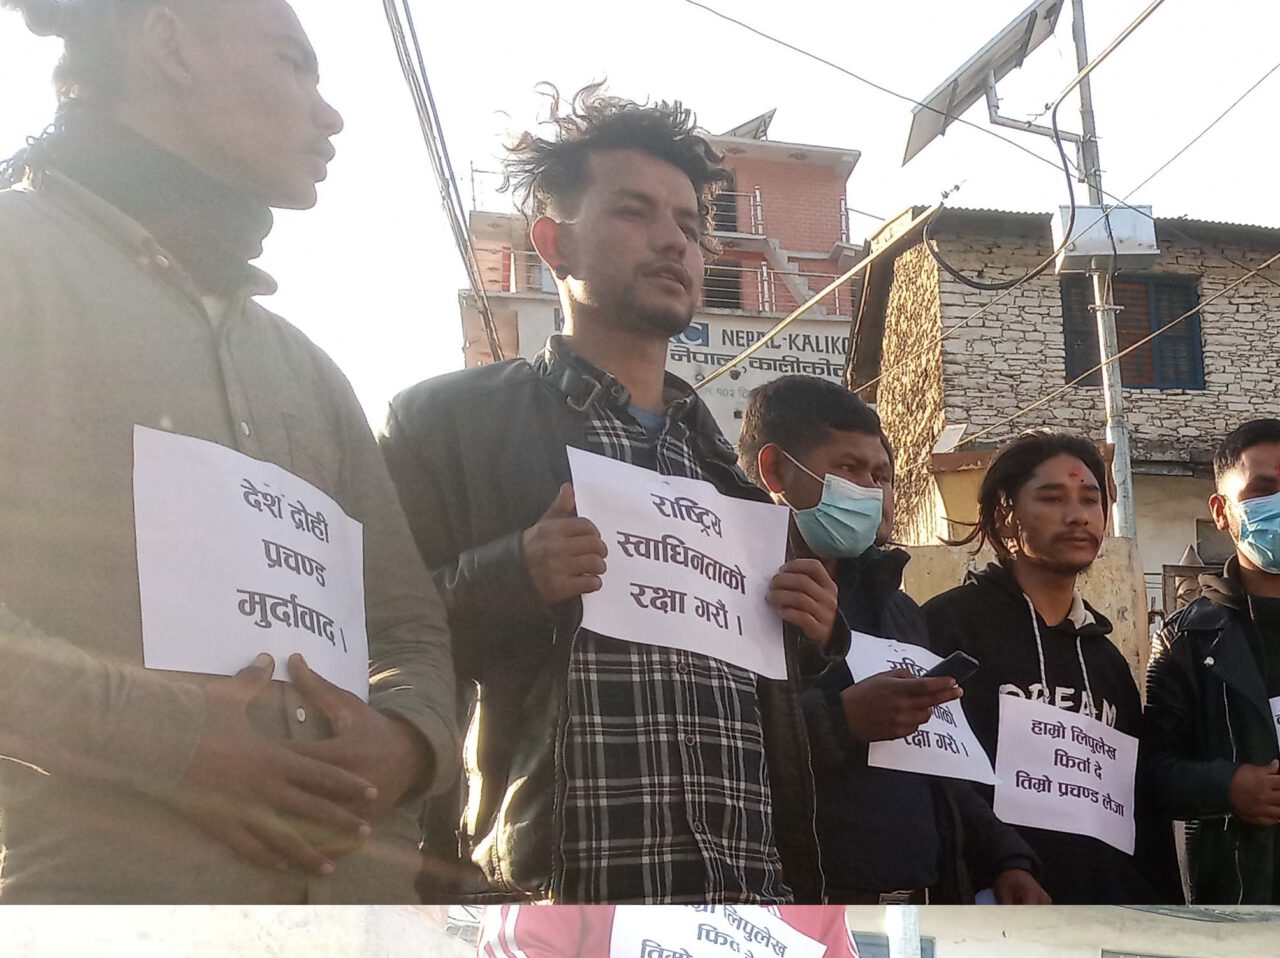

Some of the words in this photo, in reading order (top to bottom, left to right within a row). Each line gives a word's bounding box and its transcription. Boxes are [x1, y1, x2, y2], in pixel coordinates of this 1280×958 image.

[288, 500, 330, 543] द्रोही
[261, 539, 326, 587] प्रचण्ड
[630, 583, 687, 614] रक्षा
[1031, 719, 1067, 739] हाम्रो
[1015, 770, 1052, 793] तिम्रो
[1058, 781, 1101, 804] प्रचण्ड
